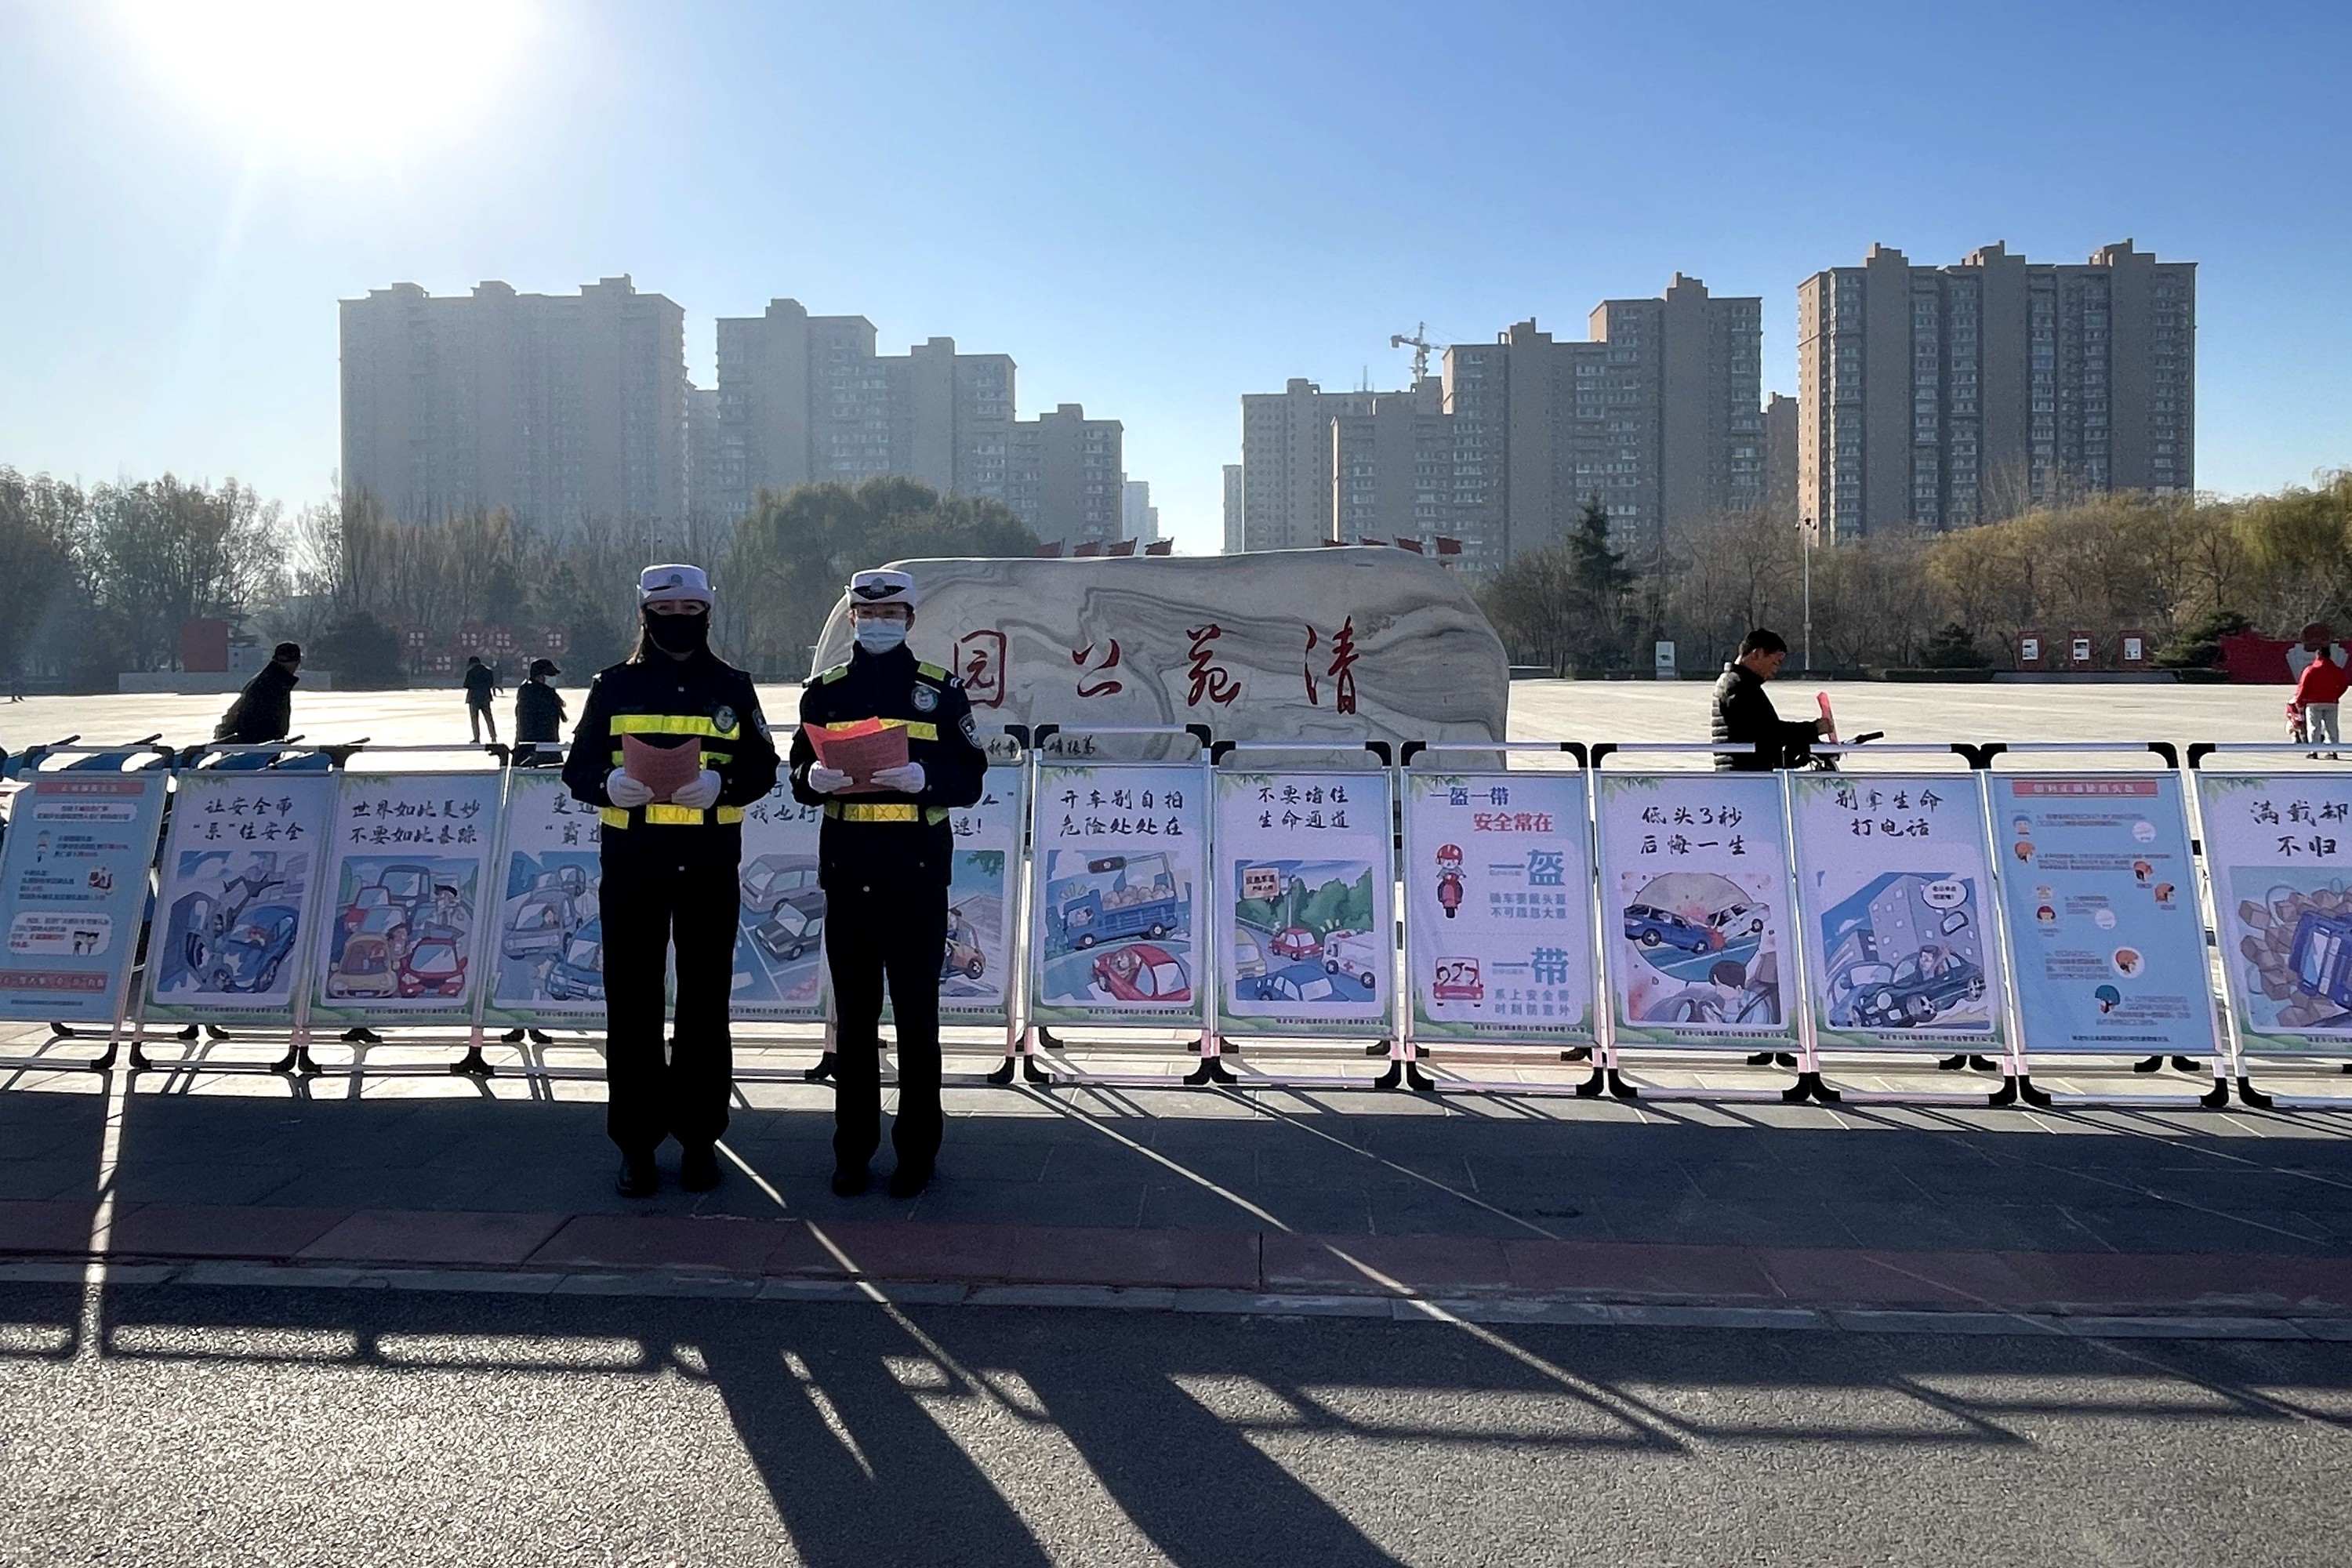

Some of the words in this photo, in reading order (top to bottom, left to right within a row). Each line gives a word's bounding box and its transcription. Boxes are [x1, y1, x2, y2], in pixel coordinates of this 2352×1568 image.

[1060, 789, 1183, 810] 开车别自拍
[1258, 785, 1348, 804] 不要堵住
[1429, 786, 1509, 806] 一盔一带
[1835, 789, 1944, 813] 别拿生命
[204, 797, 293, 817] 让安全带
[352, 799, 481, 820] 世界如此美妙
[1642, 805, 1742, 828] 低头3秒
[2250, 800, 2349, 827] 满载却
[1060, 814, 1183, 837] 危险处处在
[1258, 809, 1350, 831] 生命通道
[1473, 812, 1554, 832] 安全常在
[1851, 818, 1929, 837] 打电话
[1640, 833, 1745, 855] 后悔一生
[2277, 835, 2336, 858] 不归
[1489, 848, 1566, 886] 一盔
[1492, 946, 1569, 985] 一带
